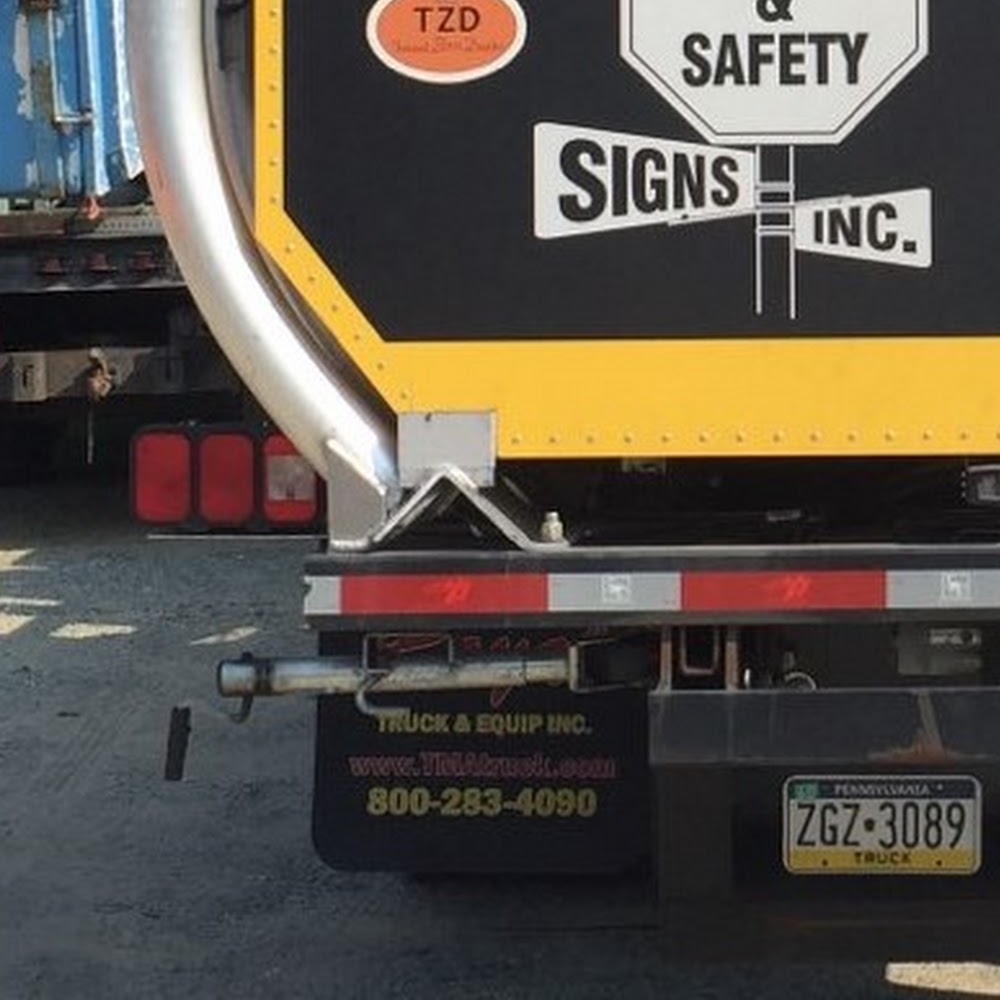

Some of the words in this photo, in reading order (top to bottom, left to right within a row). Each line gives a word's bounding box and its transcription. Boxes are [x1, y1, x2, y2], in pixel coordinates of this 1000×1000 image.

[414, 6, 481, 33] TZD
[682, 33, 868, 86] SAFETY
[558, 138, 740, 222] SIGNS
[814, 202, 917, 254] INC.
[377, 714, 448, 733] TRUCK
[453, 714, 470, 732] &
[476, 713, 542, 735] EQUIP
[547, 714, 592, 734] INC.
[367, 787, 598, 816] 800-283-4090
[833, 784, 931, 796] PENNSYLVANIA
[797, 802, 860, 846] ZGZ
[879, 801, 966, 849] 3089
[853, 851, 912, 864] TRUCK
